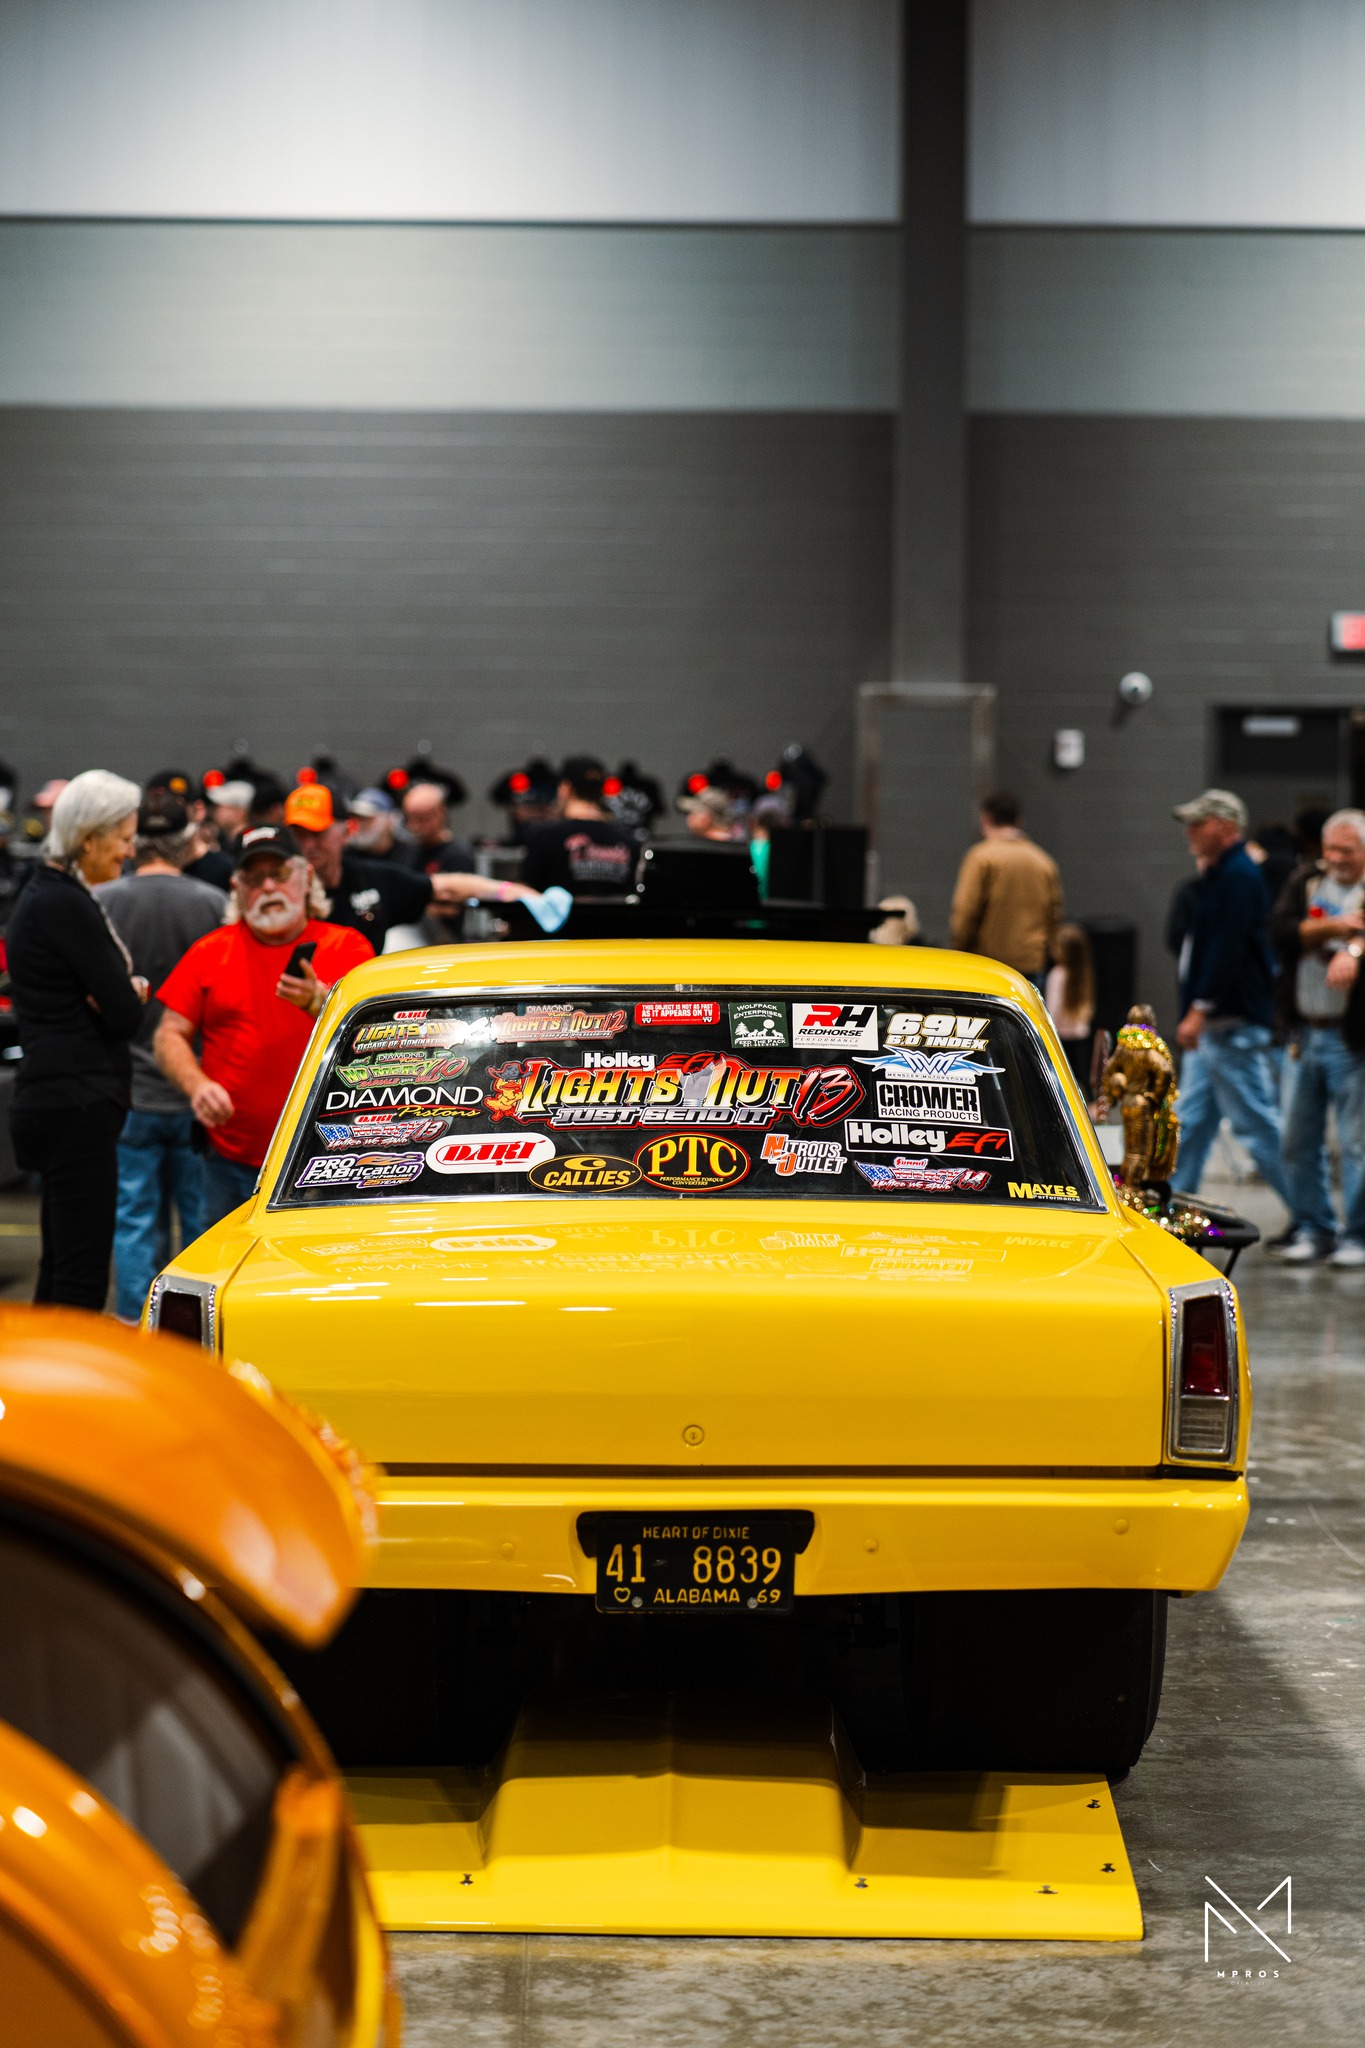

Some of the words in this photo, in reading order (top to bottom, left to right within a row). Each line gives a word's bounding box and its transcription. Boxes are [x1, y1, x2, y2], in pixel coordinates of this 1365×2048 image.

[527, 1004, 574, 1013] DIAMOND
[734, 1010, 782, 1020] ENTERPRISES
[802, 1005, 875, 1028] RH
[502, 1016, 561, 1035] LIGHTS
[570, 1012, 604, 1032] OUT
[602, 1010, 626, 1032] 12
[888, 1012, 990, 1038] 69V
[356, 1024, 420, 1042] LIGHTS
[798, 1028, 864, 1036] REDHORSE
[925, 1036, 990, 1051] INDEX
[378, 1052, 424, 1062] DIAMOND
[584, 1052, 655, 1072] Holley
[516, 1060, 682, 1113] LIGHTS
[702, 1058, 801, 1107] OUT
[793, 1070, 854, 1120] 13
[326, 1086, 483, 1110] DIAMOND
[879, 1084, 978, 1112] CROWER
[397, 1106, 481, 1117] Pistons
[553, 1107, 638, 1124] JUST
[642, 1107, 734, 1123] SEND
[736, 1107, 775, 1122] IT
[881, 1108, 920, 1117] RACING
[923, 1110, 979, 1121] PRODUCTS
[849, 1122, 946, 1152] Holley
[946, 1132, 1008, 1154] EFI
[440, 1141, 540, 1163] DART
[765, 1135, 840, 1159] NITROUS
[314, 1158, 356, 1170] PRO
[647, 1136, 738, 1177] PTC
[778, 1153, 845, 1174] OUTLET
[306, 1164, 420, 1181] FABrication
[543, 1170, 632, 1186] CALLIES
[1008, 1182, 1078, 1199] MAYES
[643, 1527, 688, 1539] HEART
[692, 1527, 710, 1538] OF
[713, 1527, 750, 1539] DIXIE
[606, 1544, 646, 1583] 41
[693, 1546, 782, 1584] 8839
[654, 1588, 740, 1604] ALABAMA
[757, 1588, 781, 1604] 69
